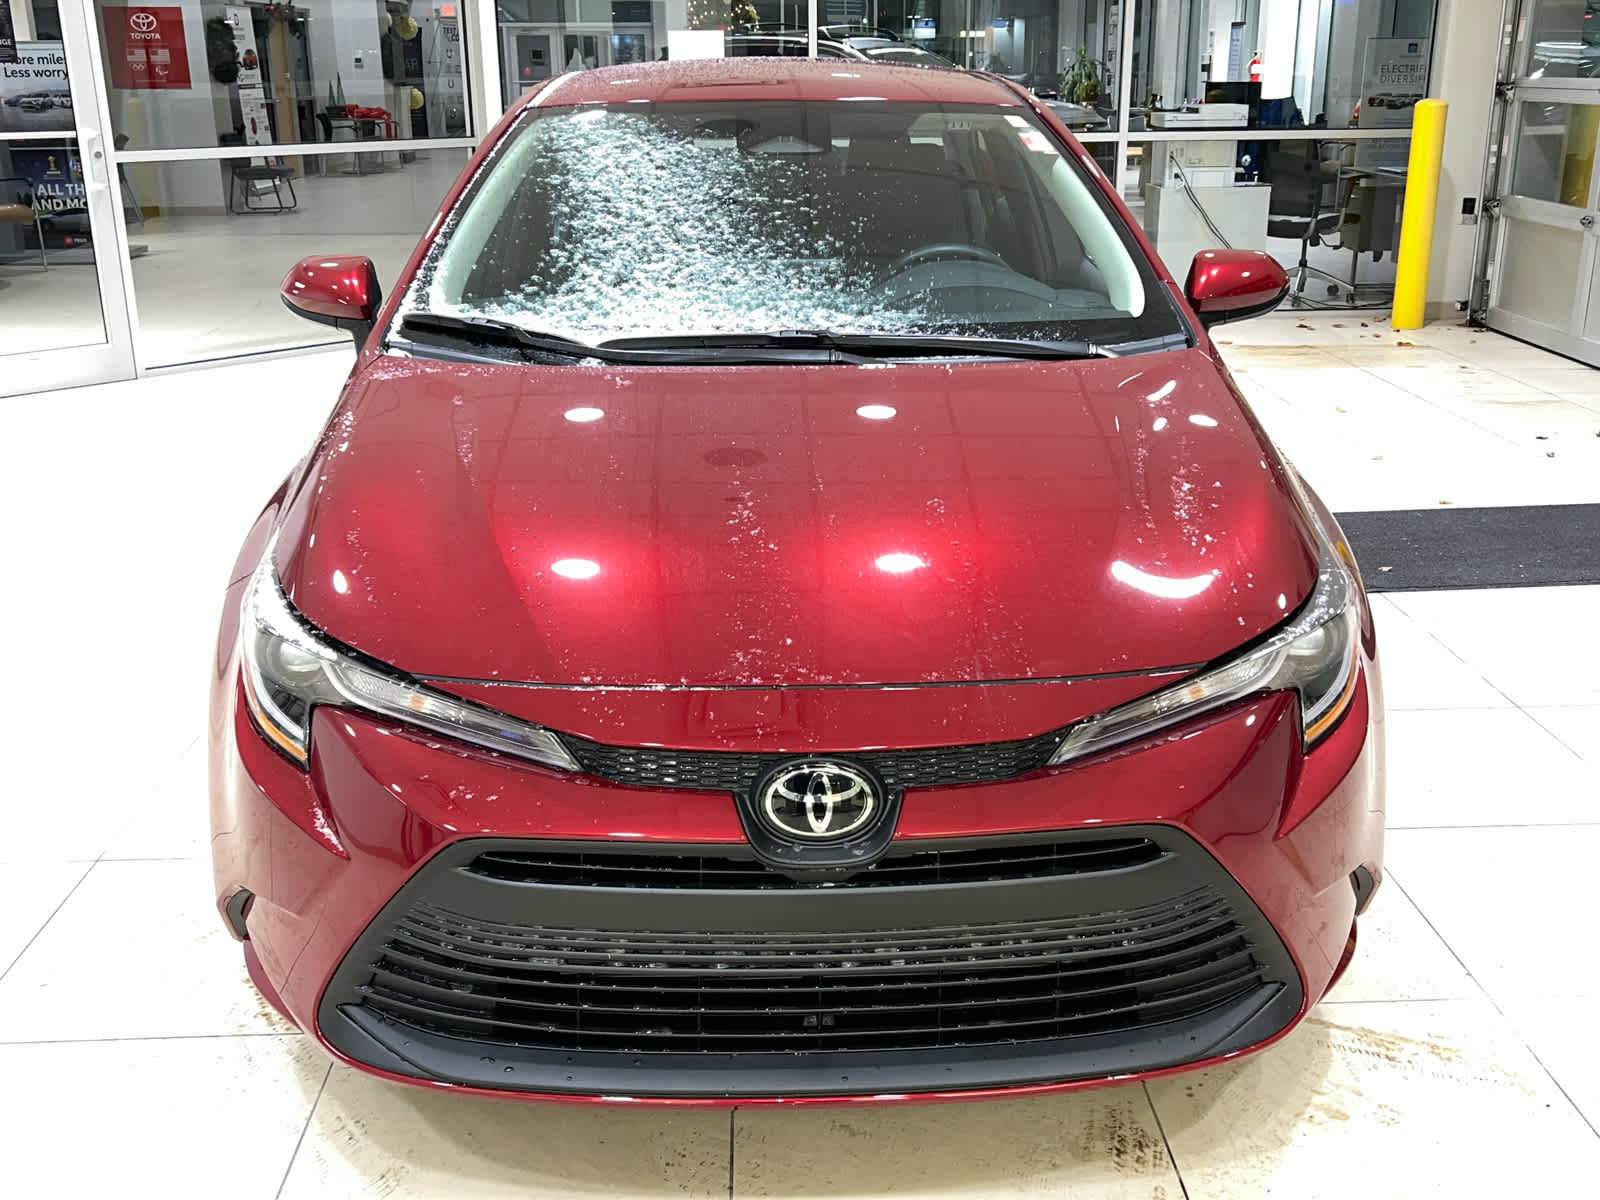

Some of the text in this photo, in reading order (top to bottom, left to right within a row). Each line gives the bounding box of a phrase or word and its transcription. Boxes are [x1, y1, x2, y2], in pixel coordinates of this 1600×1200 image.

[130, 32, 160, 40] TOYOTA
[4, 67, 68, 80] Less worry
[37, 183, 65, 196] ALL
[32, 198, 64, 210] AND
